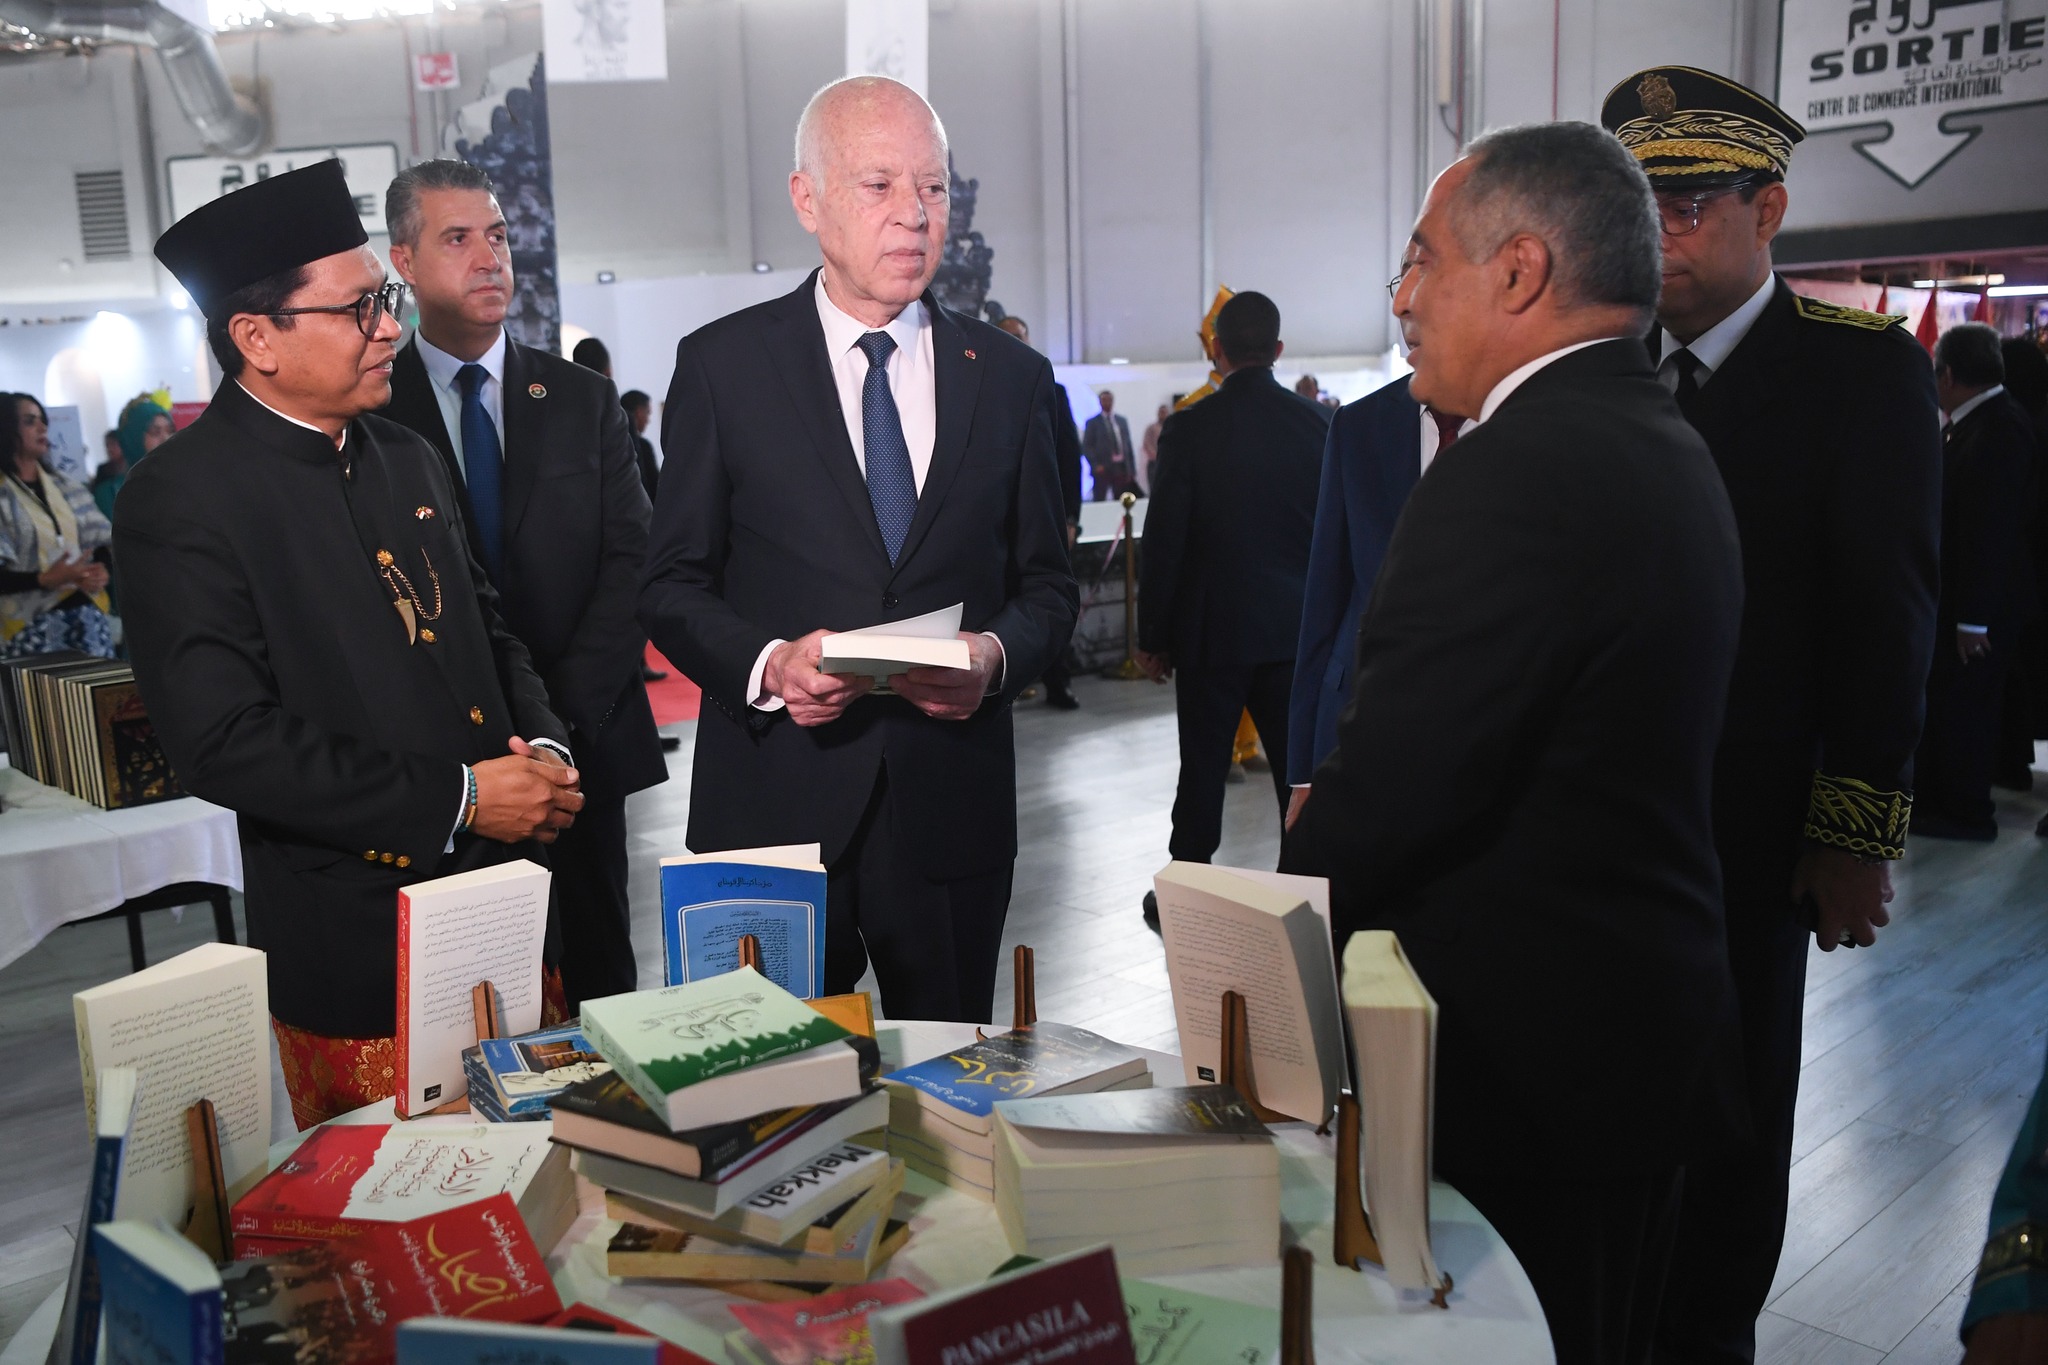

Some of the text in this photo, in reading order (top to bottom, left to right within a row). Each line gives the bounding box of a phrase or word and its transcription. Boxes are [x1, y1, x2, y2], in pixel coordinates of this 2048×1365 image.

[1809, 16, 2045, 83] SORTIE
[1955, 57, 2001, 81] التجارة
[1808, 76, 2003, 119] CENTRE DE COMMERCE INTERNATIONAL
[748, 1146, 873, 1207] Mekkah
[943, 1301, 1089, 1365] PANCASILA
